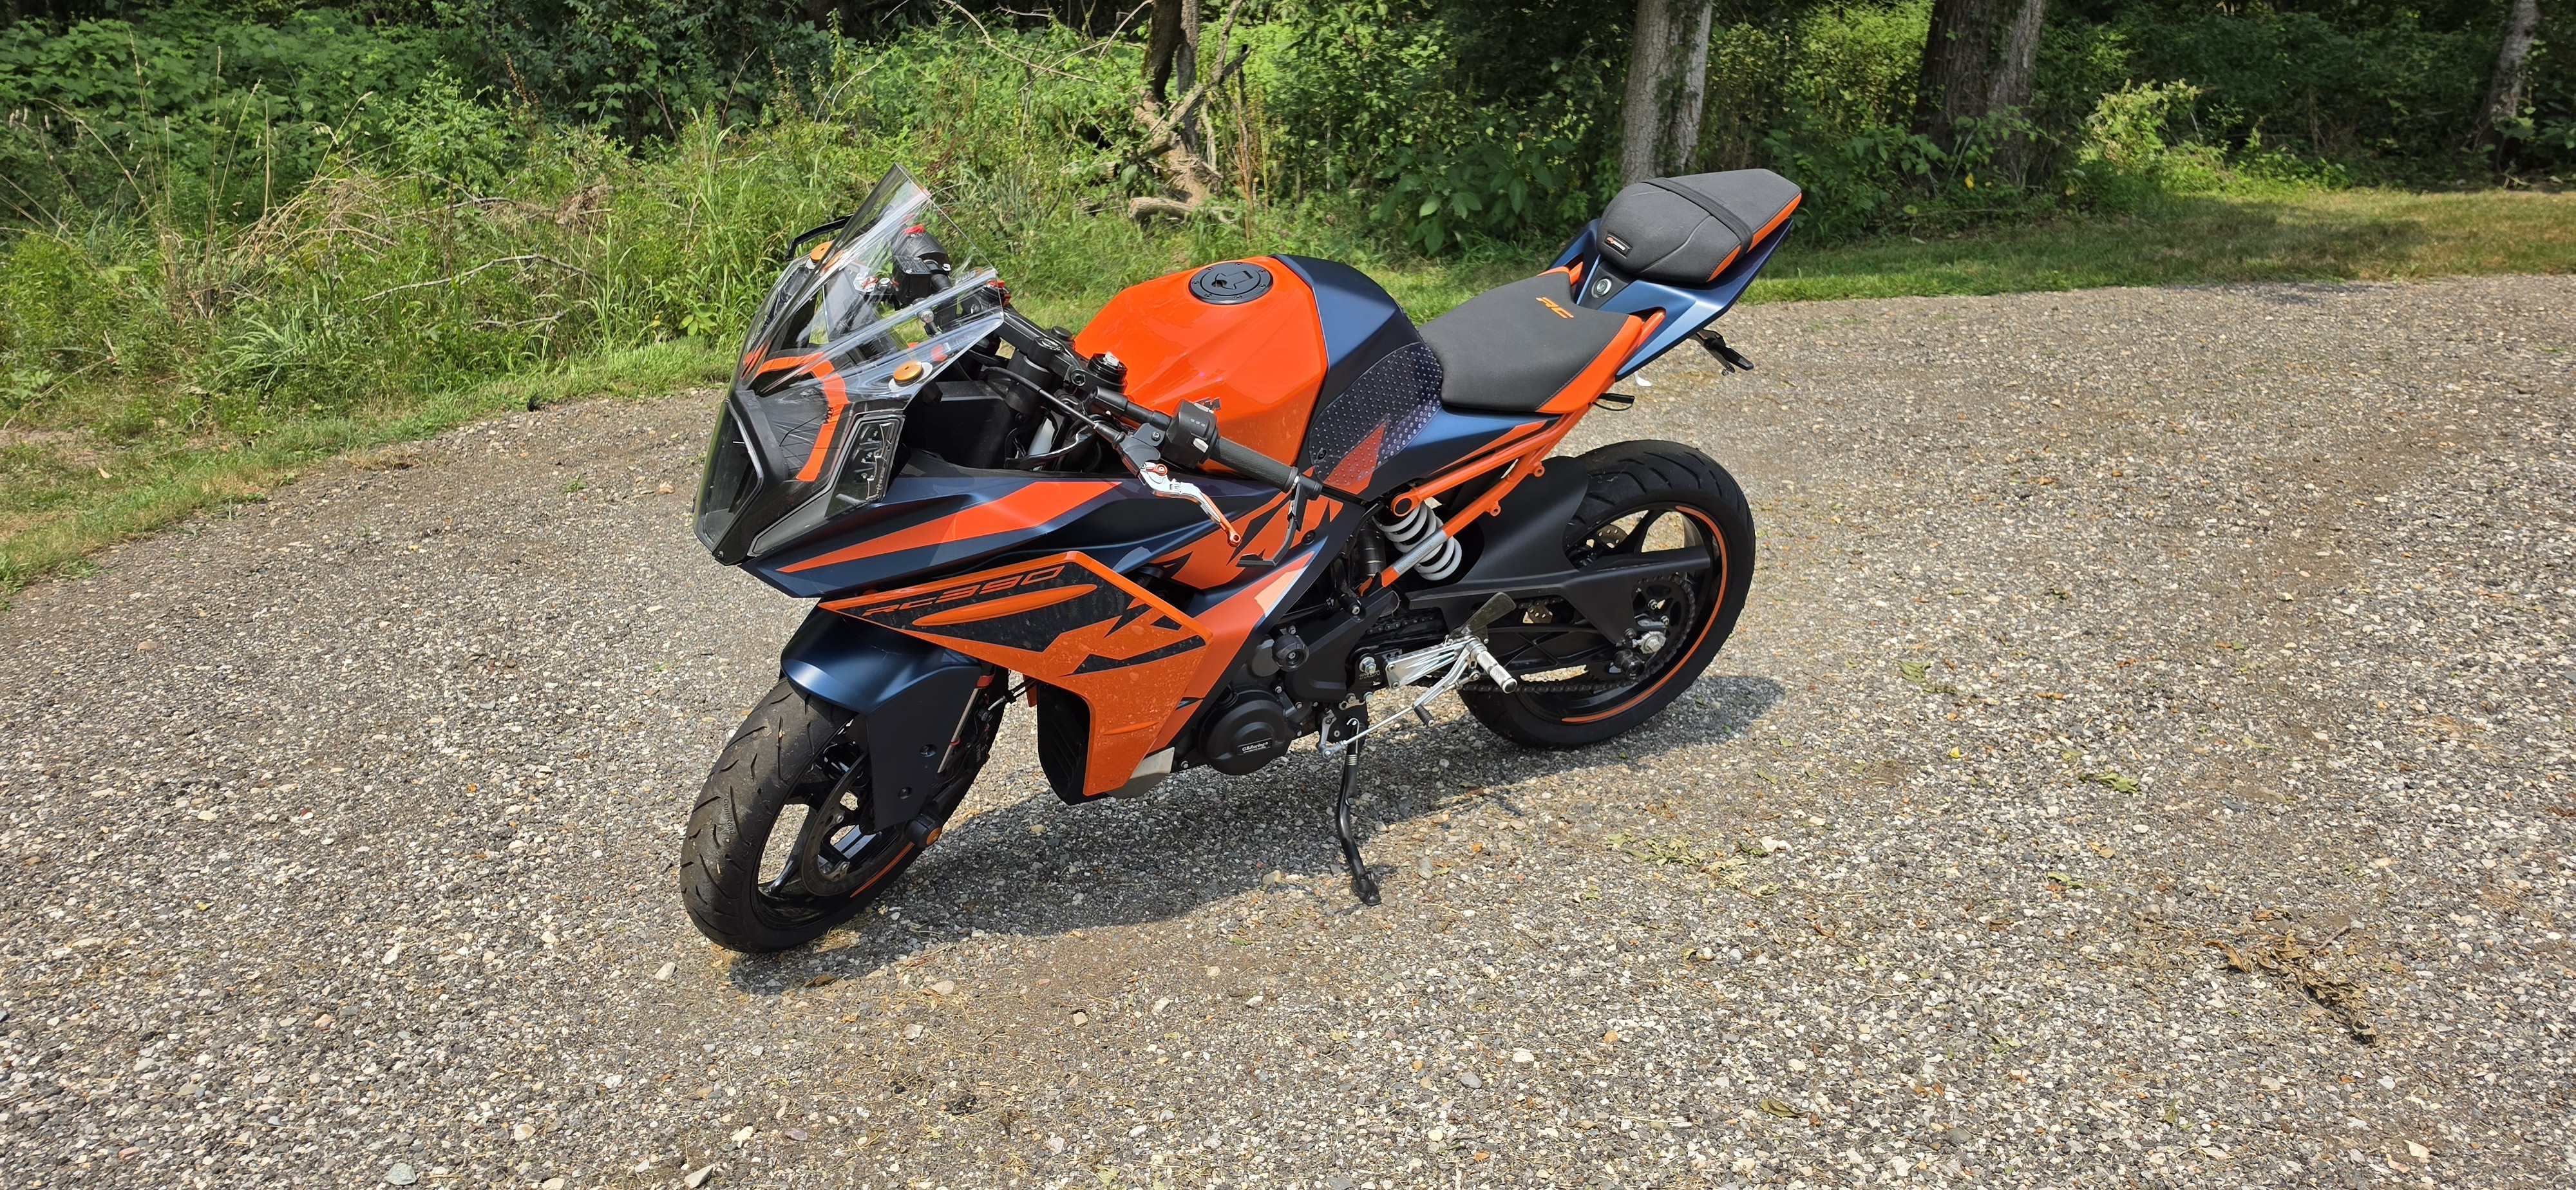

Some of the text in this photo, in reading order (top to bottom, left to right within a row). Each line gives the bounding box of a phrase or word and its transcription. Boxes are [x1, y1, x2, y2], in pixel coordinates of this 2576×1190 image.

[1536, 297, 1574, 318] RC
[862, 565, 1065, 616] RC390
[723, 798, 736, 835] ContiRoad
